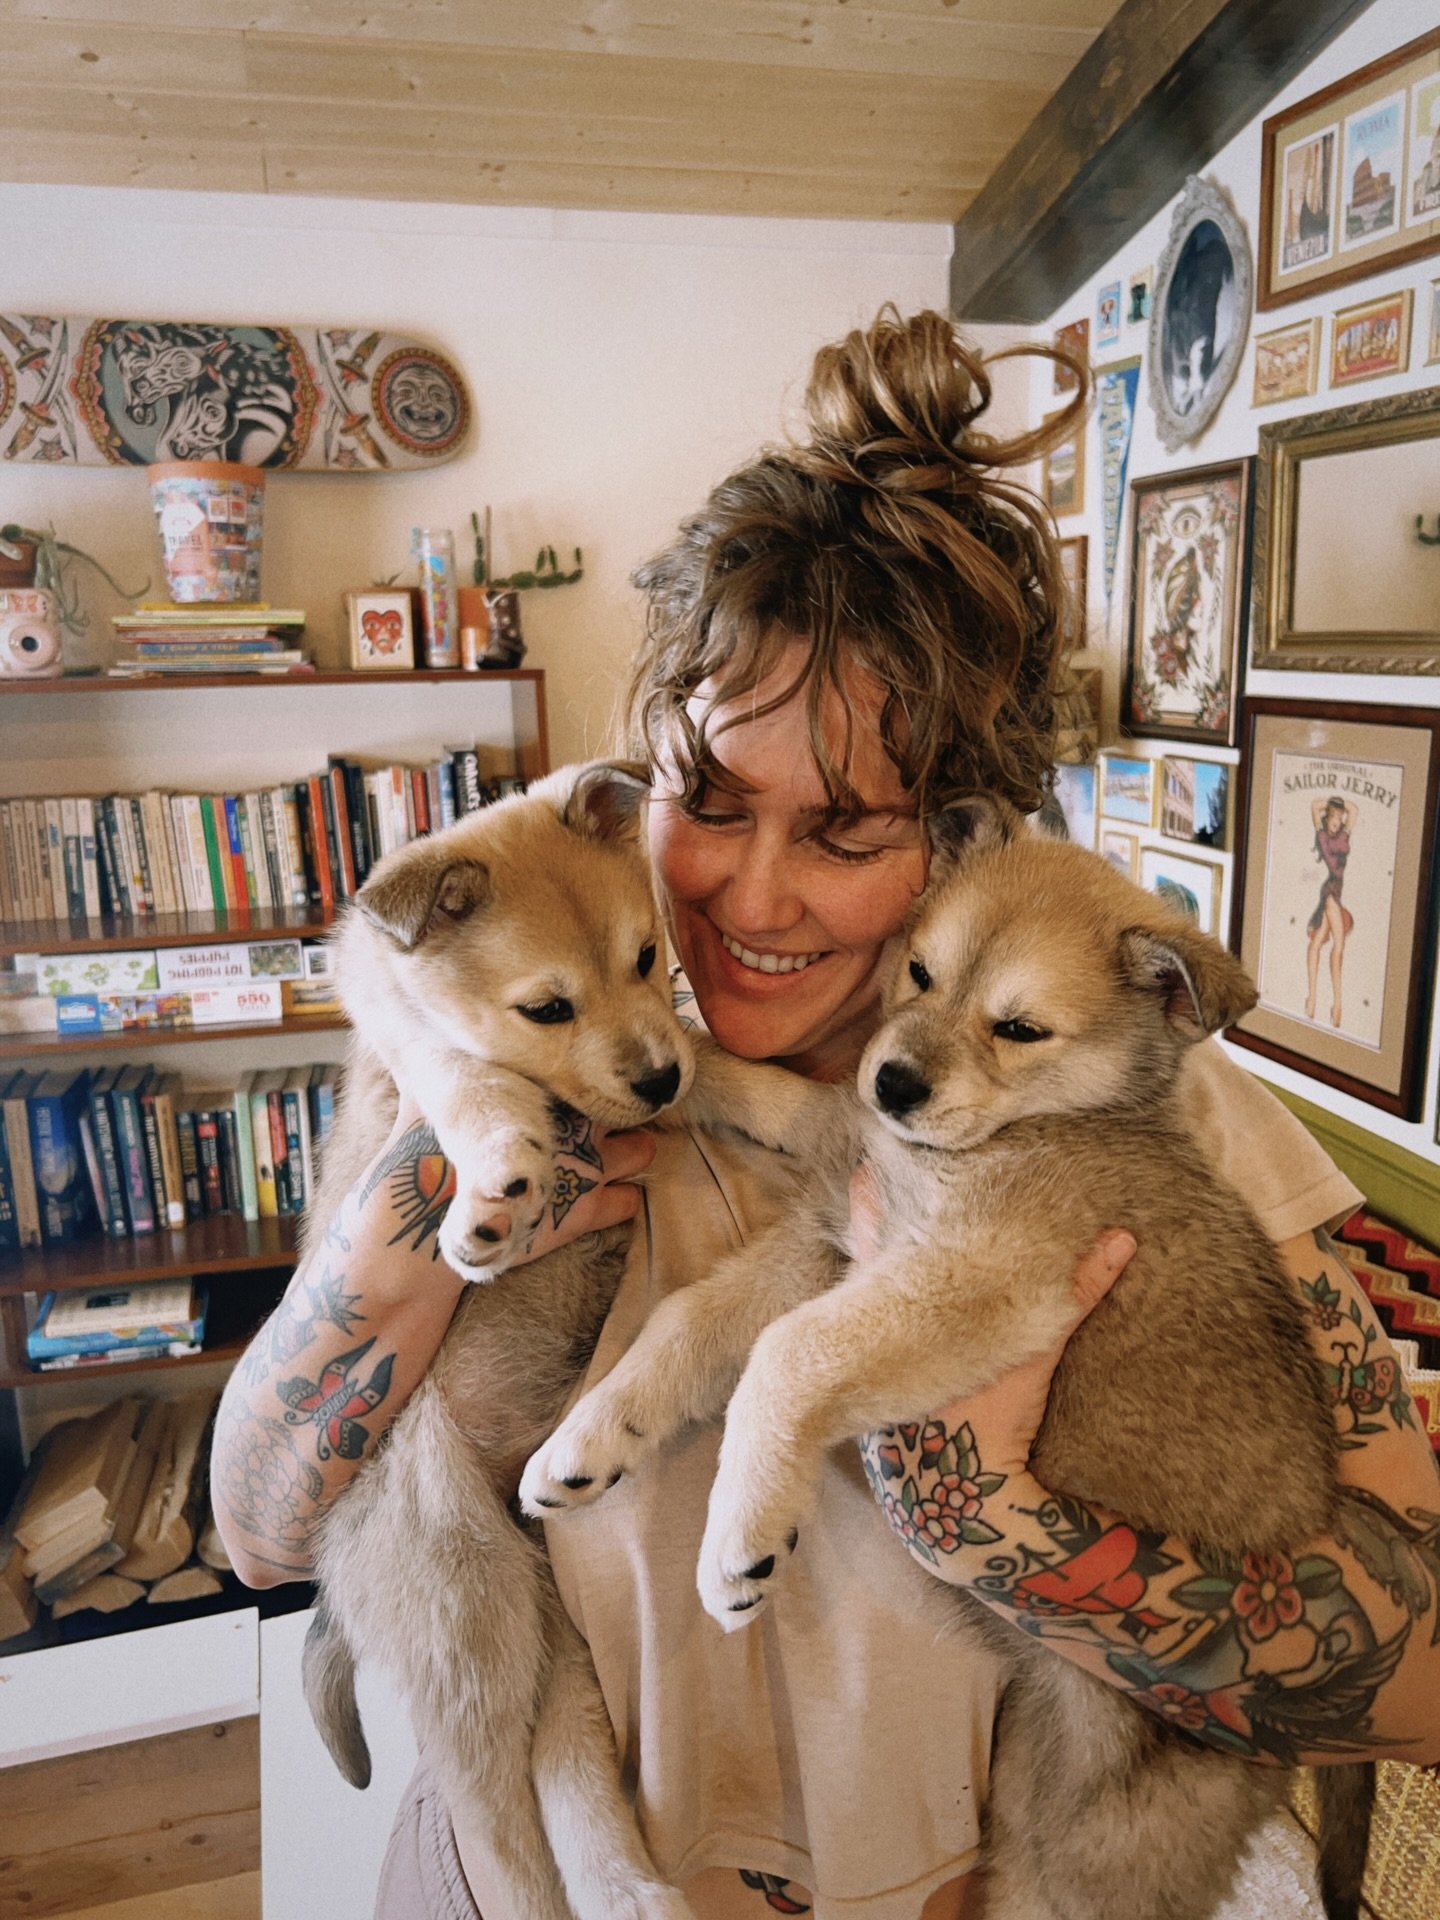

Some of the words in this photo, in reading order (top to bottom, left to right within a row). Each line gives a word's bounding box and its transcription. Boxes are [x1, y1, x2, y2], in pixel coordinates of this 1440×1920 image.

[463, 753, 481, 810] CHARLES
[1283, 773, 1337, 794] SAILOR
[1341, 776, 1398, 808] JERRY
[179, 949, 231, 965] PUPPIES
[168, 966, 222, 981] POOPING
[225, 964, 244, 977] 101
